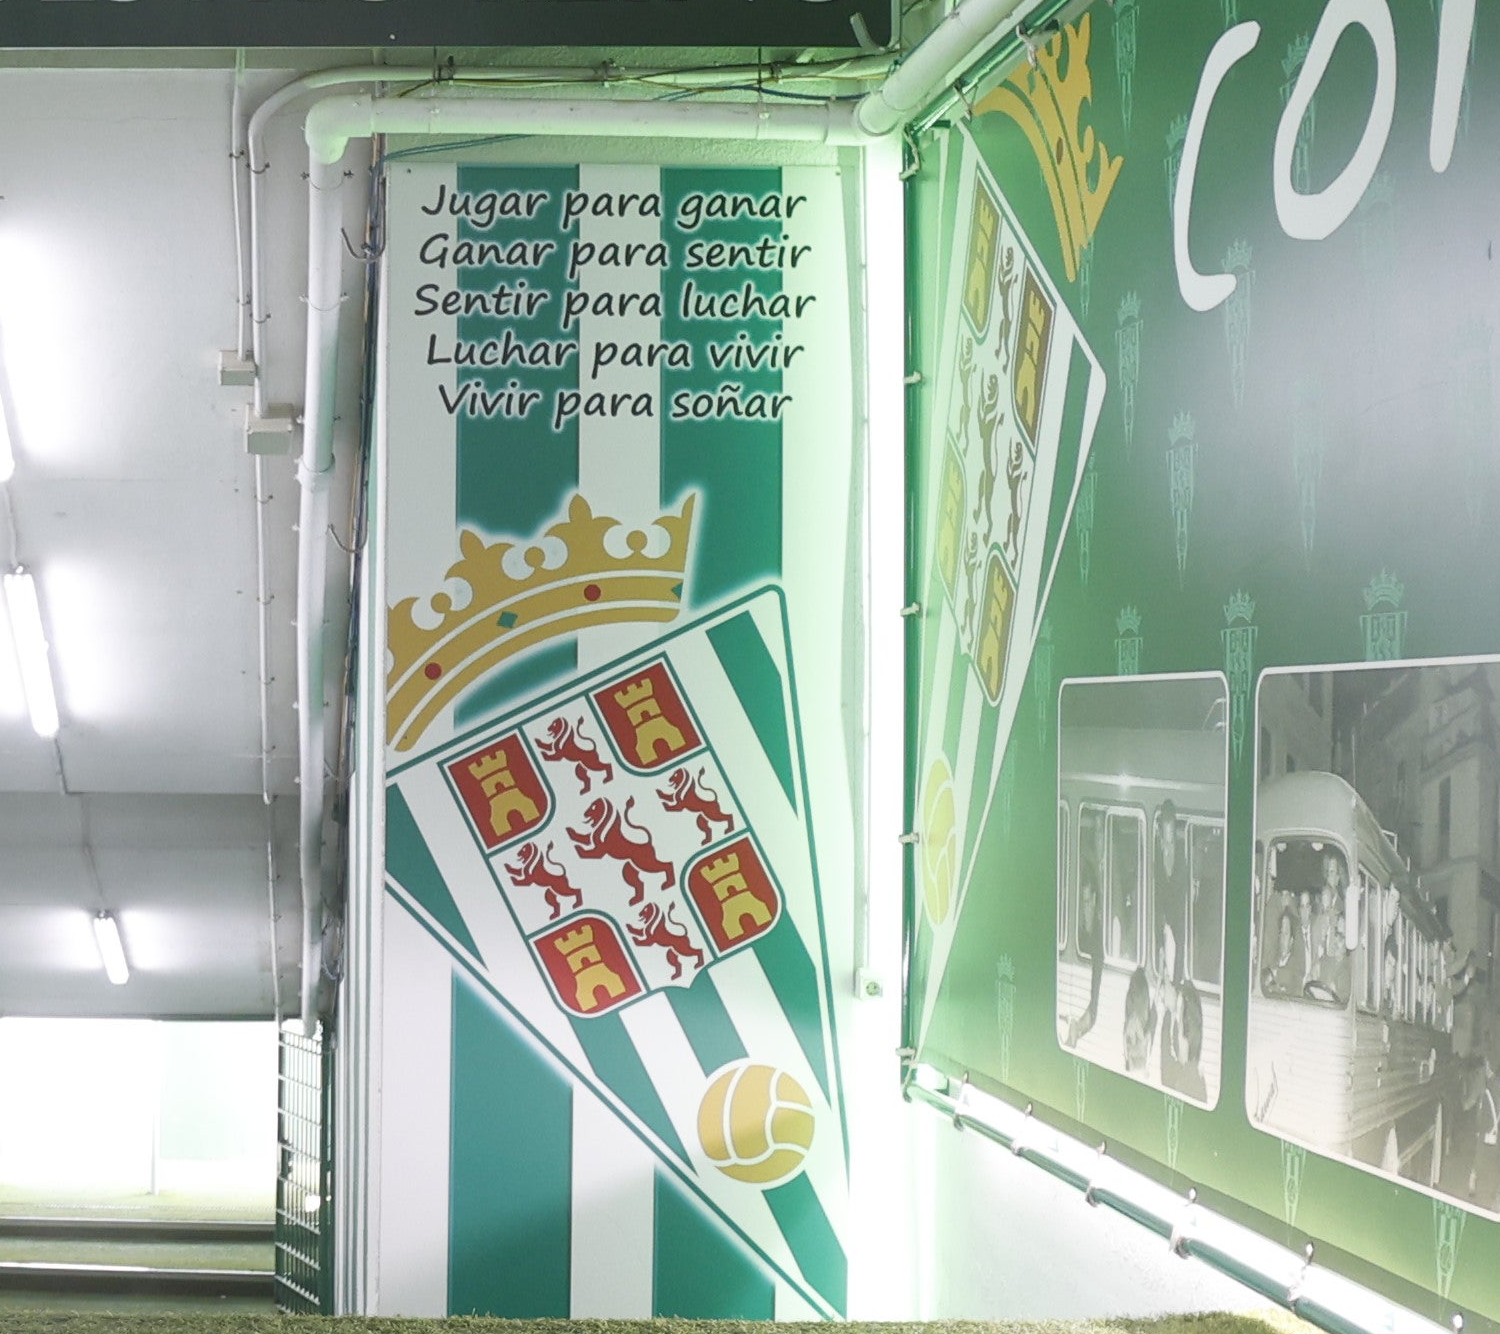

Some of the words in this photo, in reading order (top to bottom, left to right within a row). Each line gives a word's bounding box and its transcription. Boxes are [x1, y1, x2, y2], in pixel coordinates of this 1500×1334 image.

[421, 184, 548, 228] Jugar
[562, 190, 662, 230] para
[677, 192, 808, 229] ganar
[419, 232, 556, 269] Ganar
[568, 239, 670, 279] para
[685, 234, 812, 269] sentir
[414, 281, 549, 317] Sentir
[562, 290, 662, 330] para
[681, 281, 817, 319] luchar
[427, 330, 577, 367] Luchar
[591, 339, 692, 380] para
[708, 333, 805, 369] vivir
[438, 381, 541, 417] Vivir
[554, 390, 654, 431] para
[671, 384, 794, 419] soñar
